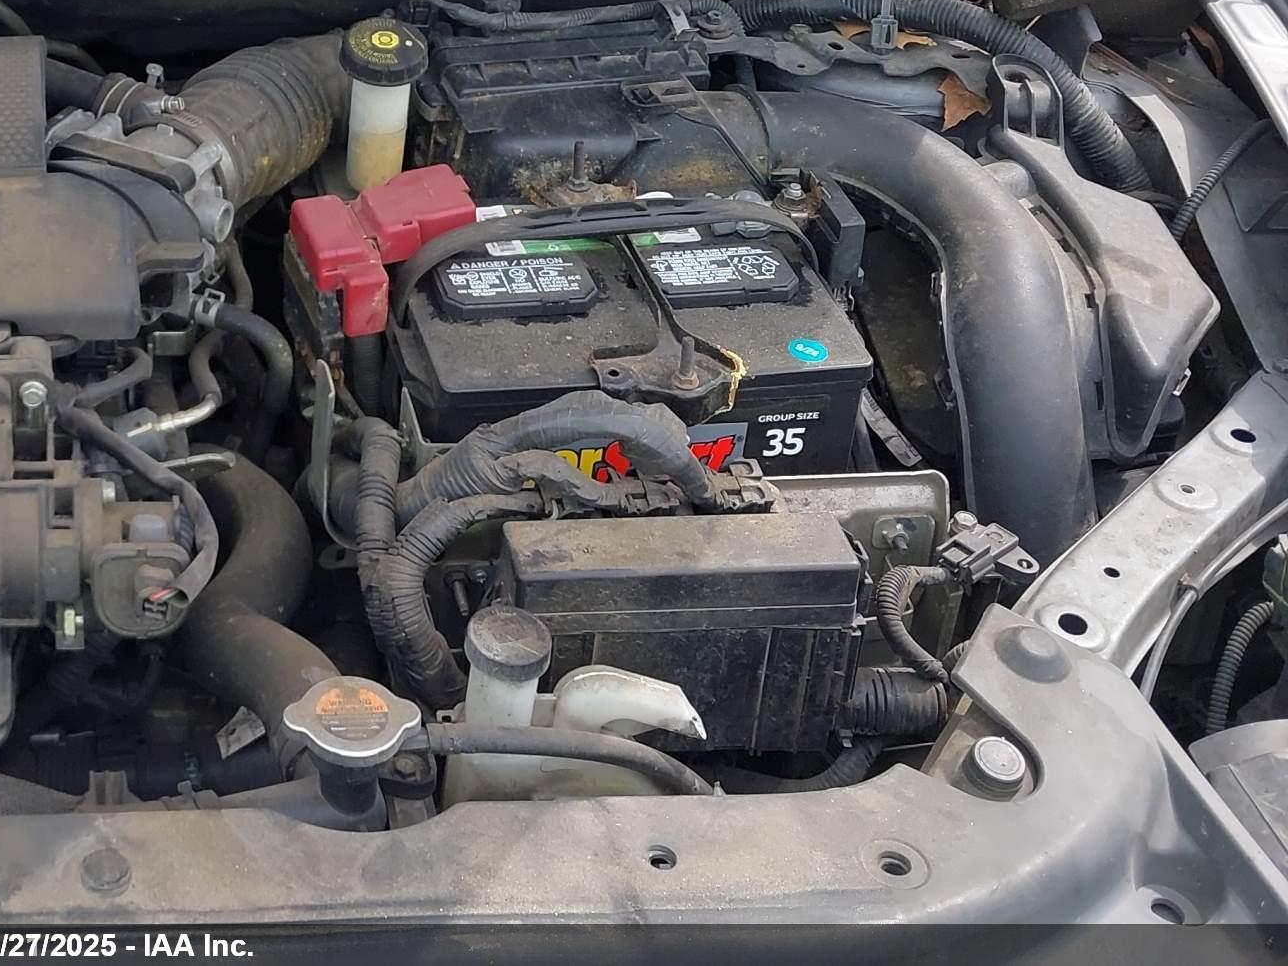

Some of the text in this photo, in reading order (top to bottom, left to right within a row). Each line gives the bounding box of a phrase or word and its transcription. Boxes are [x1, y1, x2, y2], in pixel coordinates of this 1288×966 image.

[460, 259, 509, 270] DANGER
[520, 256, 564, 267] POISON
[757, 411, 821, 424] GROUP SIZE
[762, 427, 807, 458] 35
